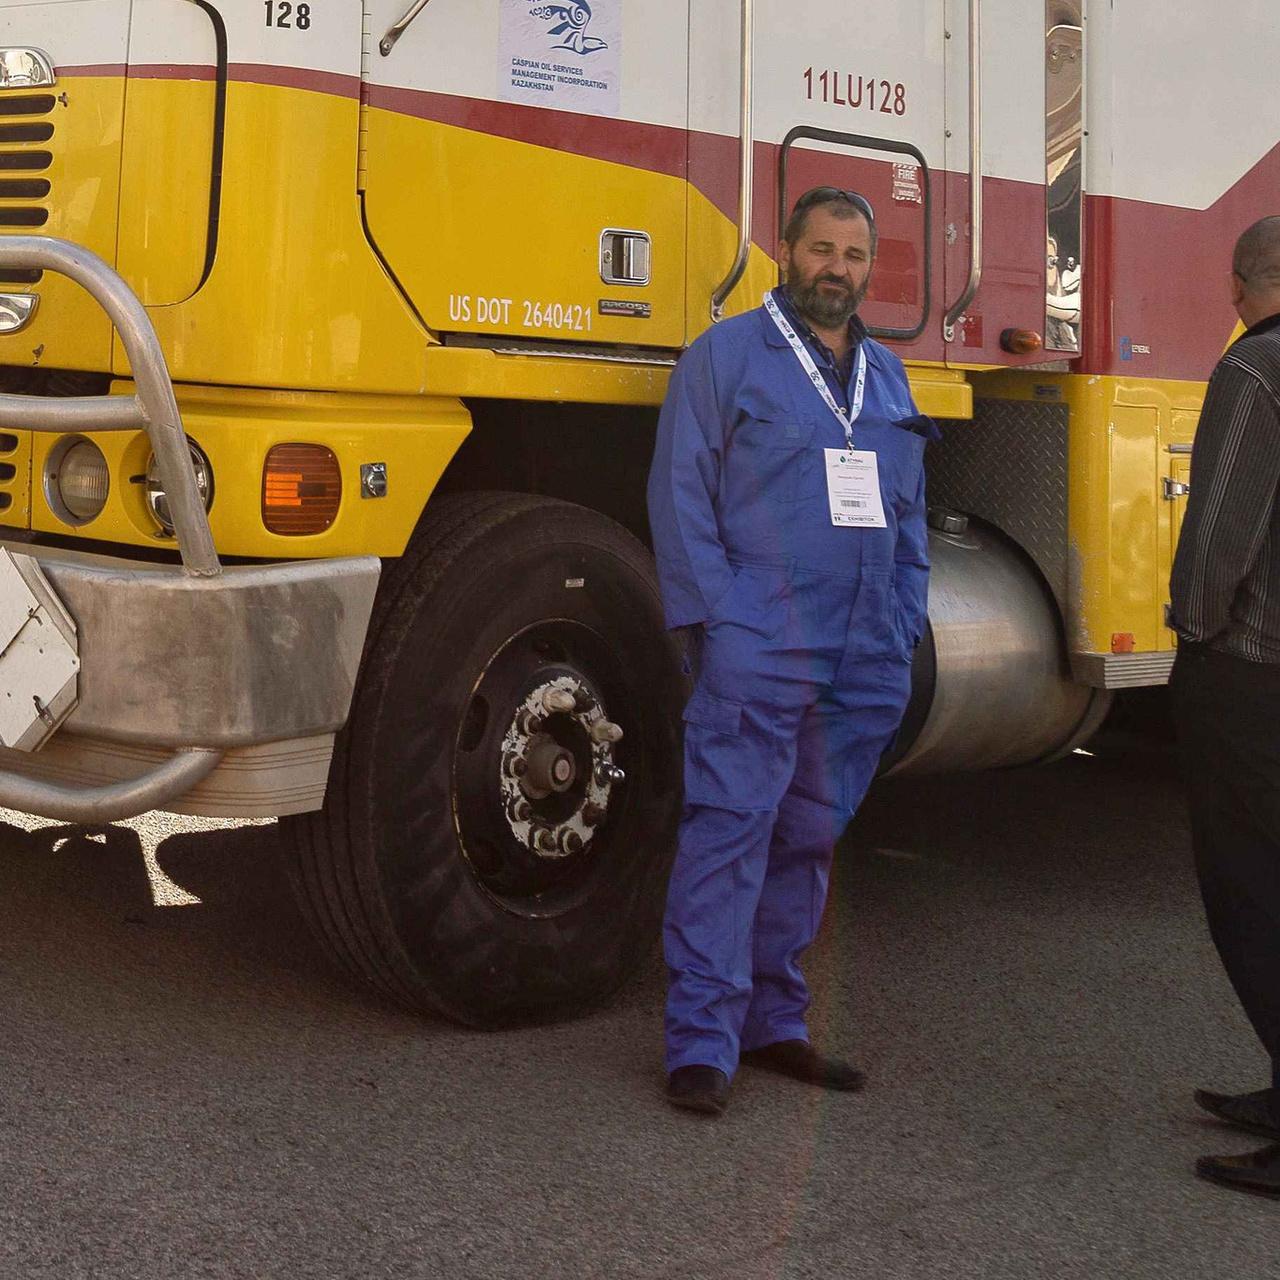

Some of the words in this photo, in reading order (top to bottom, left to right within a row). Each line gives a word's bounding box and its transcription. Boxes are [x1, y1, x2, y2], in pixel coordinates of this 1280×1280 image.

[264, 0, 311, 30] 128
[511, 58, 540, 69] CASPIAN
[541, 62, 552, 71] OIL
[552, 64, 584, 76] SERVICES
[511, 68, 556, 82] MANAGEMENT
[557, 75, 608, 90] INCORPORATION
[511, 79, 555, 92] KAZAKHSTAN
[803, 66, 906, 116] 11LU128
[898, 169, 916, 180] FIRE
[449, 294, 471, 322] US
[476, 297, 513, 325] DOT
[522, 300, 592, 331] 2640421
